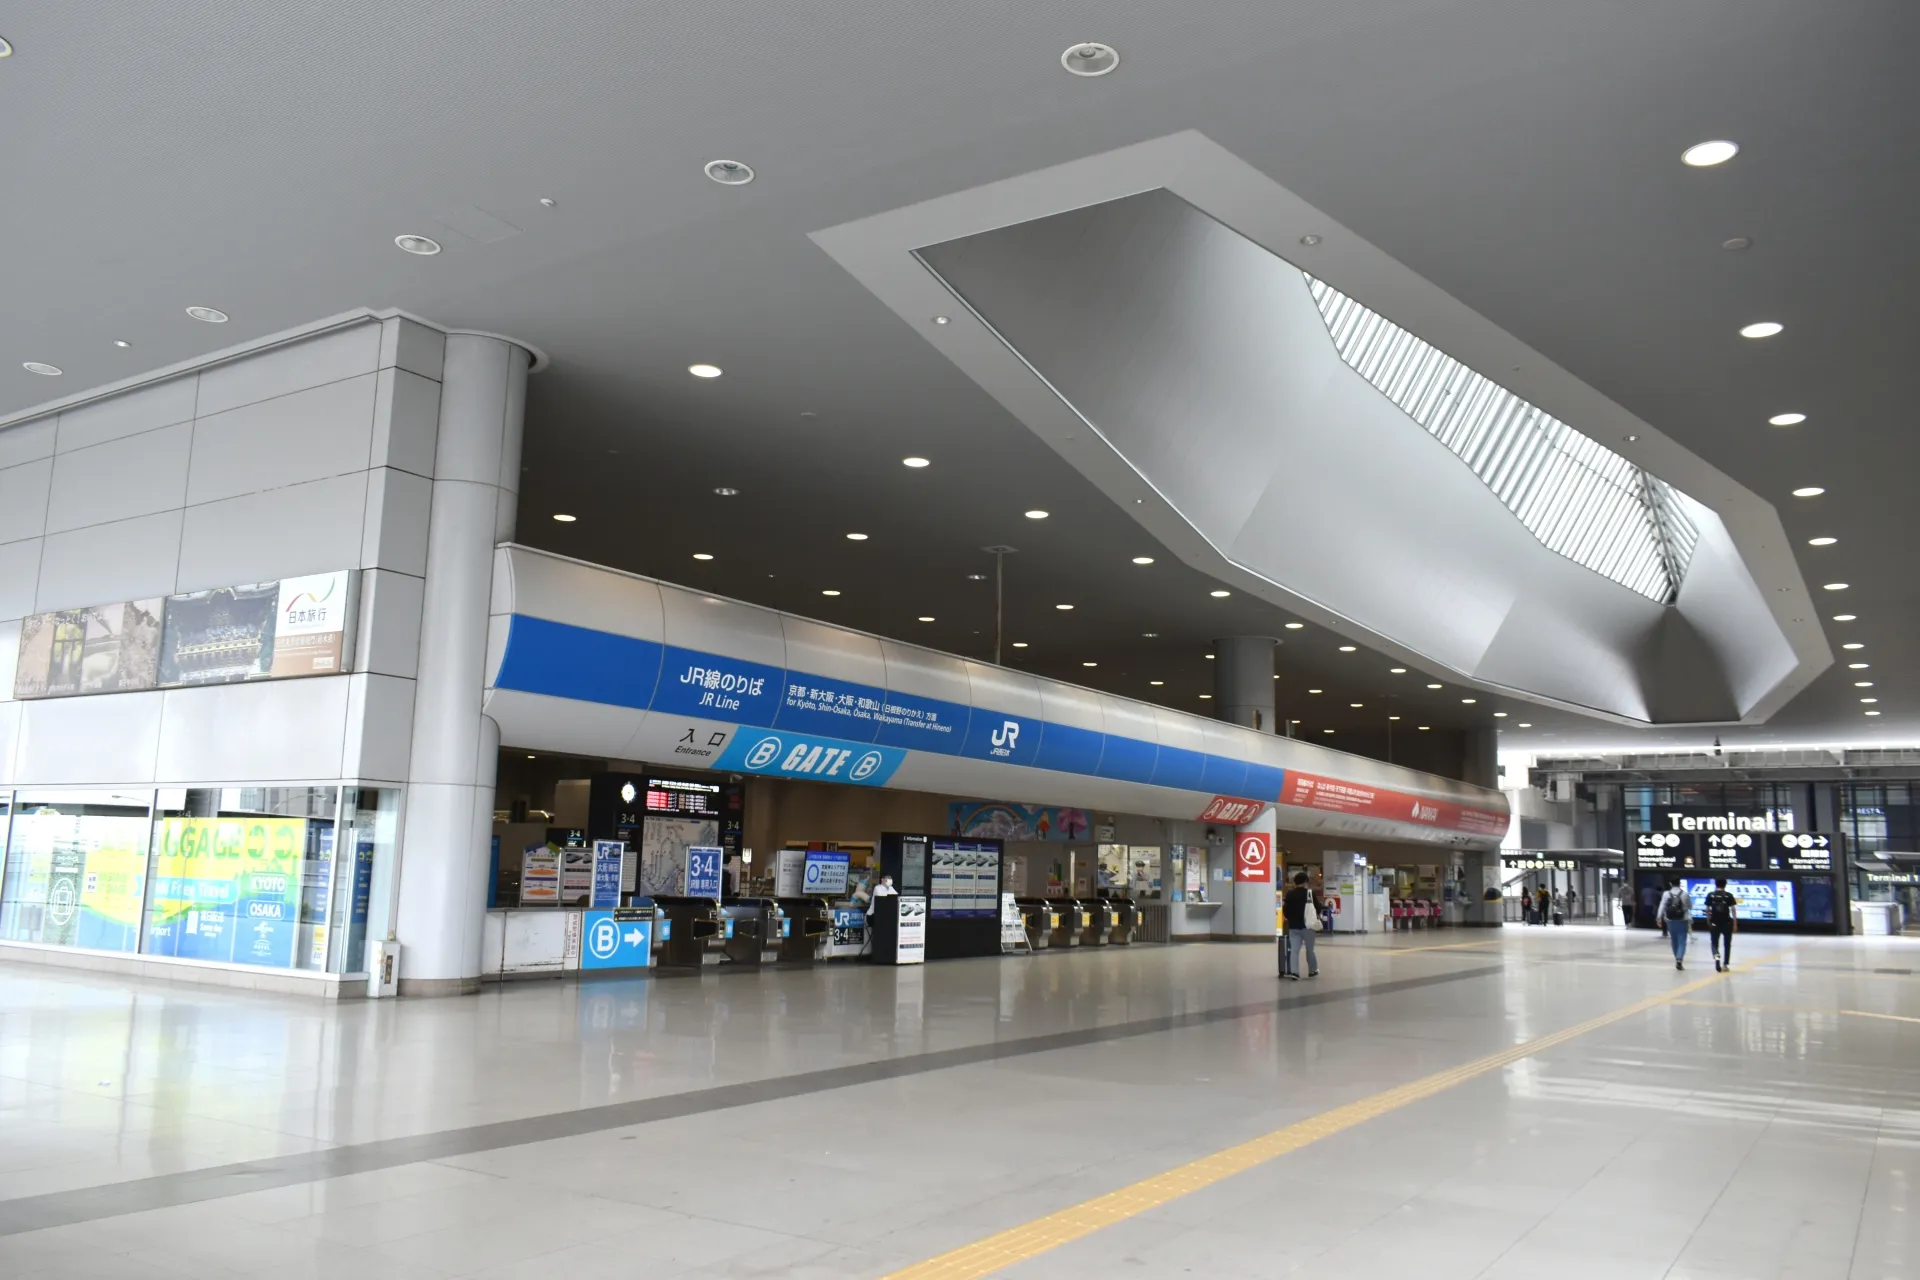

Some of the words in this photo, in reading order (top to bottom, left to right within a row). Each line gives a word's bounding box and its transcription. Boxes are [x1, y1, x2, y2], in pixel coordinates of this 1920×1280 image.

[289, 608, 327, 624] 日本旅行
[680, 666, 765, 696] JR線のりば
[699, 692, 713, 706] JR
[715, 695, 740, 710] Line
[786, 697, 796, 706] for
[873, 712, 903, 725] Wakayama
[679, 728, 726, 747] 入口
[991, 721, 1019, 749] JR
[674, 745, 712, 757] Entrance
[781, 743, 852, 777] GATE
[1216, 802, 1248, 821] GATE
[1667, 811, 1773, 831] Terminal
[1782, 812, 1794, 831] 1
[598, 846, 609, 860] JR
[251, 877, 286, 892] KYOTO
[1866, 873, 1911, 882] Terminal
[249, 903, 281, 918] OSAKA
[835, 911, 850, 926] JR
